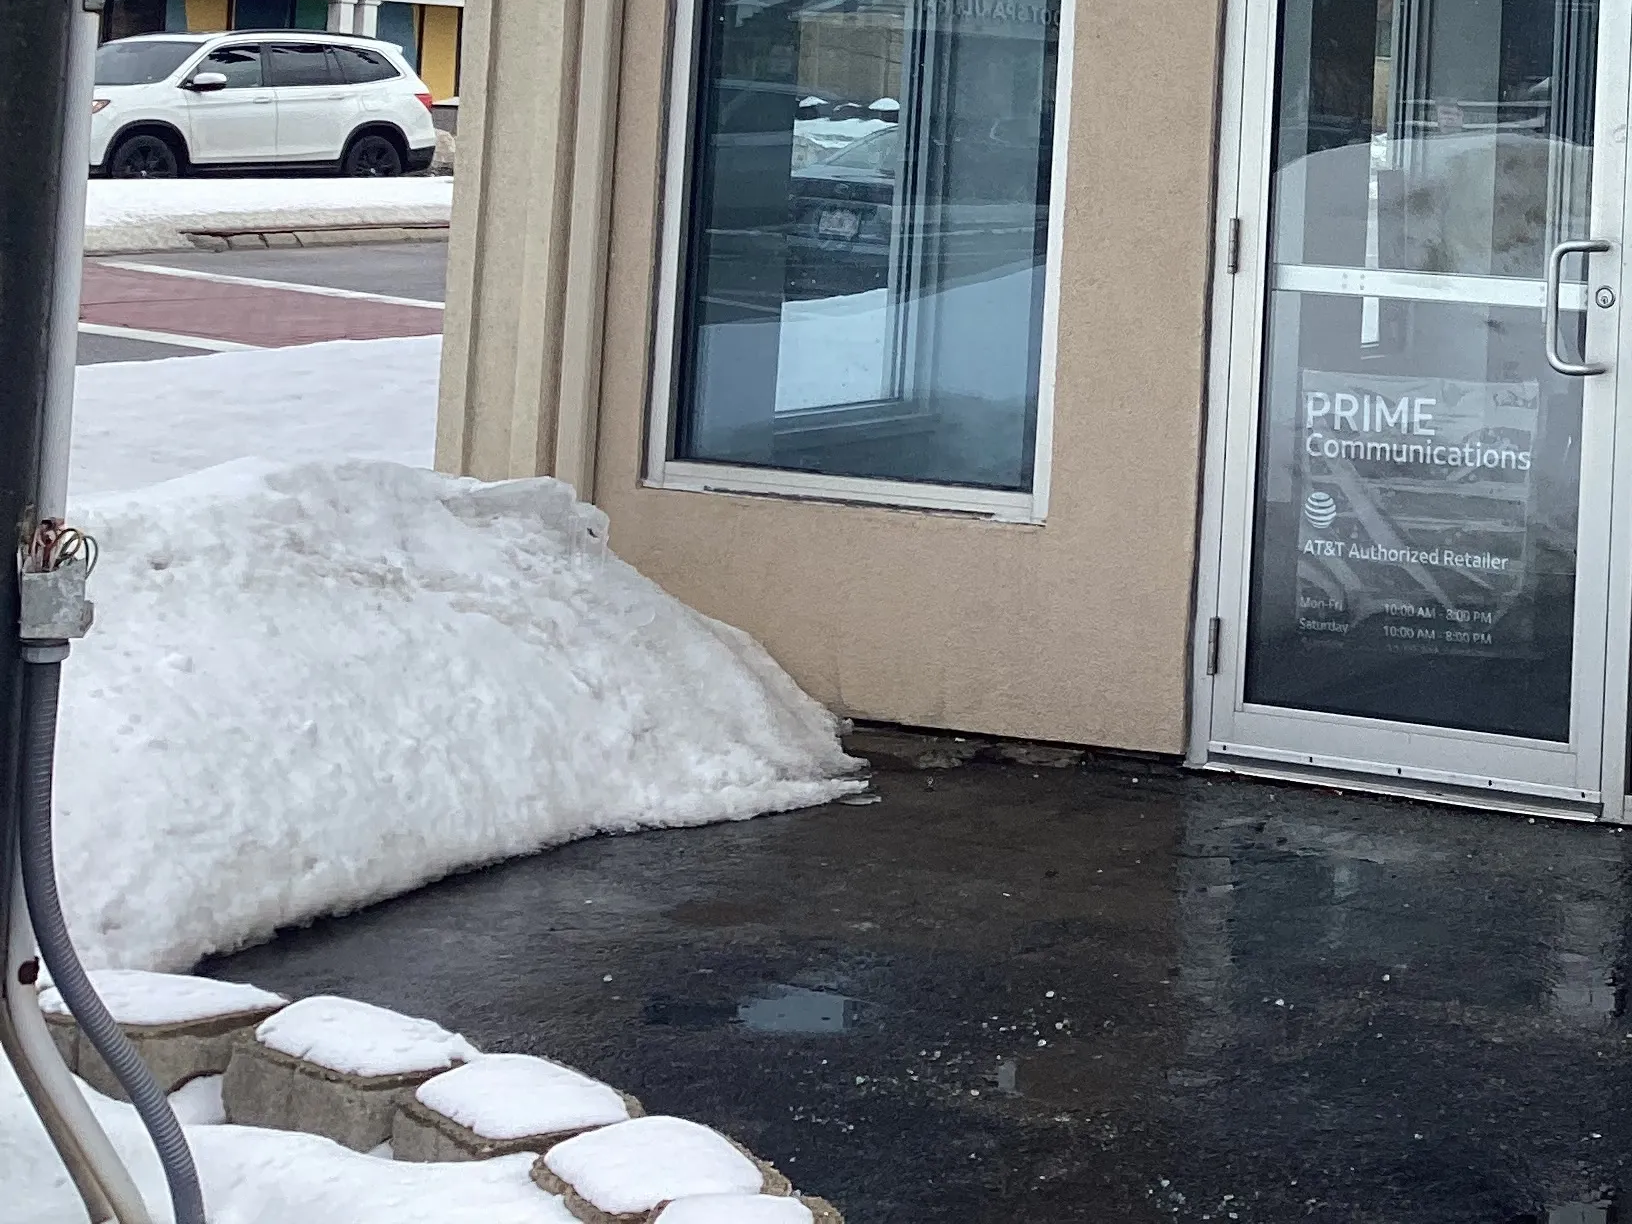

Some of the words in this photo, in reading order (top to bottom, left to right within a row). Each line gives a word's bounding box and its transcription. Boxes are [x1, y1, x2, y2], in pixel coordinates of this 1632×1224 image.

[1305, 391, 1437, 437] PRIME
[1305, 432, 1531, 471] Communications
[1303, 539, 1346, 558] AT&T
[1349, 542, 1440, 566] Authorized
[1443, 549, 1509, 571] Retailer
[1299, 596, 1343, 612] Mon-Fri
[1416, 606, 1436, 619] AM
[1473, 610, 1492, 624] PM
[1299, 617, 1349, 636] Saturday
[1382, 625, 1415, 639] 10:00
[1416, 628, 1436, 640] AM
[1472, 632, 1493, 645] PM
